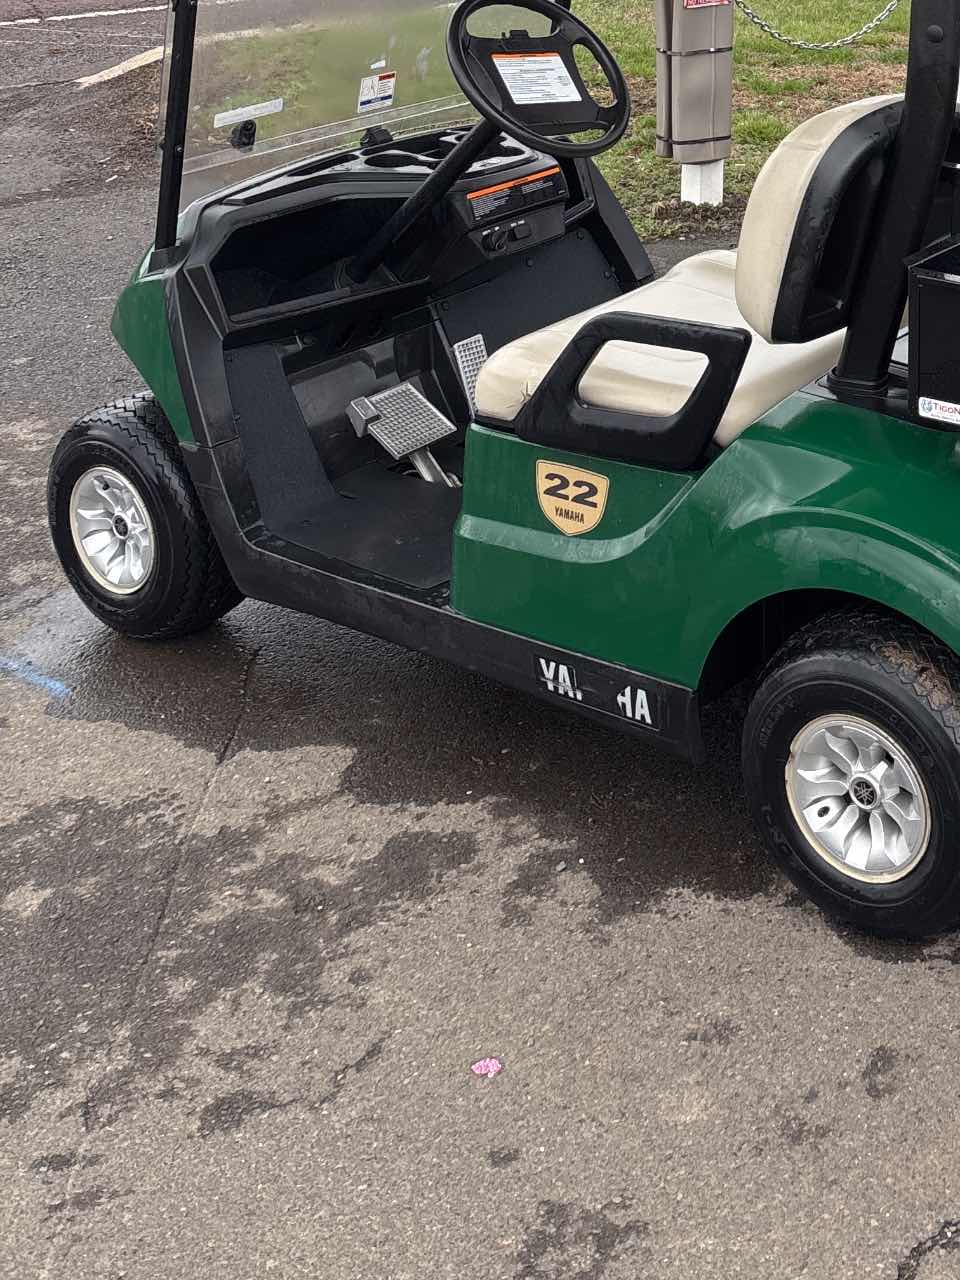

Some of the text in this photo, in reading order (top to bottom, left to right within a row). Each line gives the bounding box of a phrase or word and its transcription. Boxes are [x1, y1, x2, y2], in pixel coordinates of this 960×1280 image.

[934, 402, 960, 416] TIGON
[543, 472, 598, 509] 22
[554, 506, 585, 524] YAMAHA
